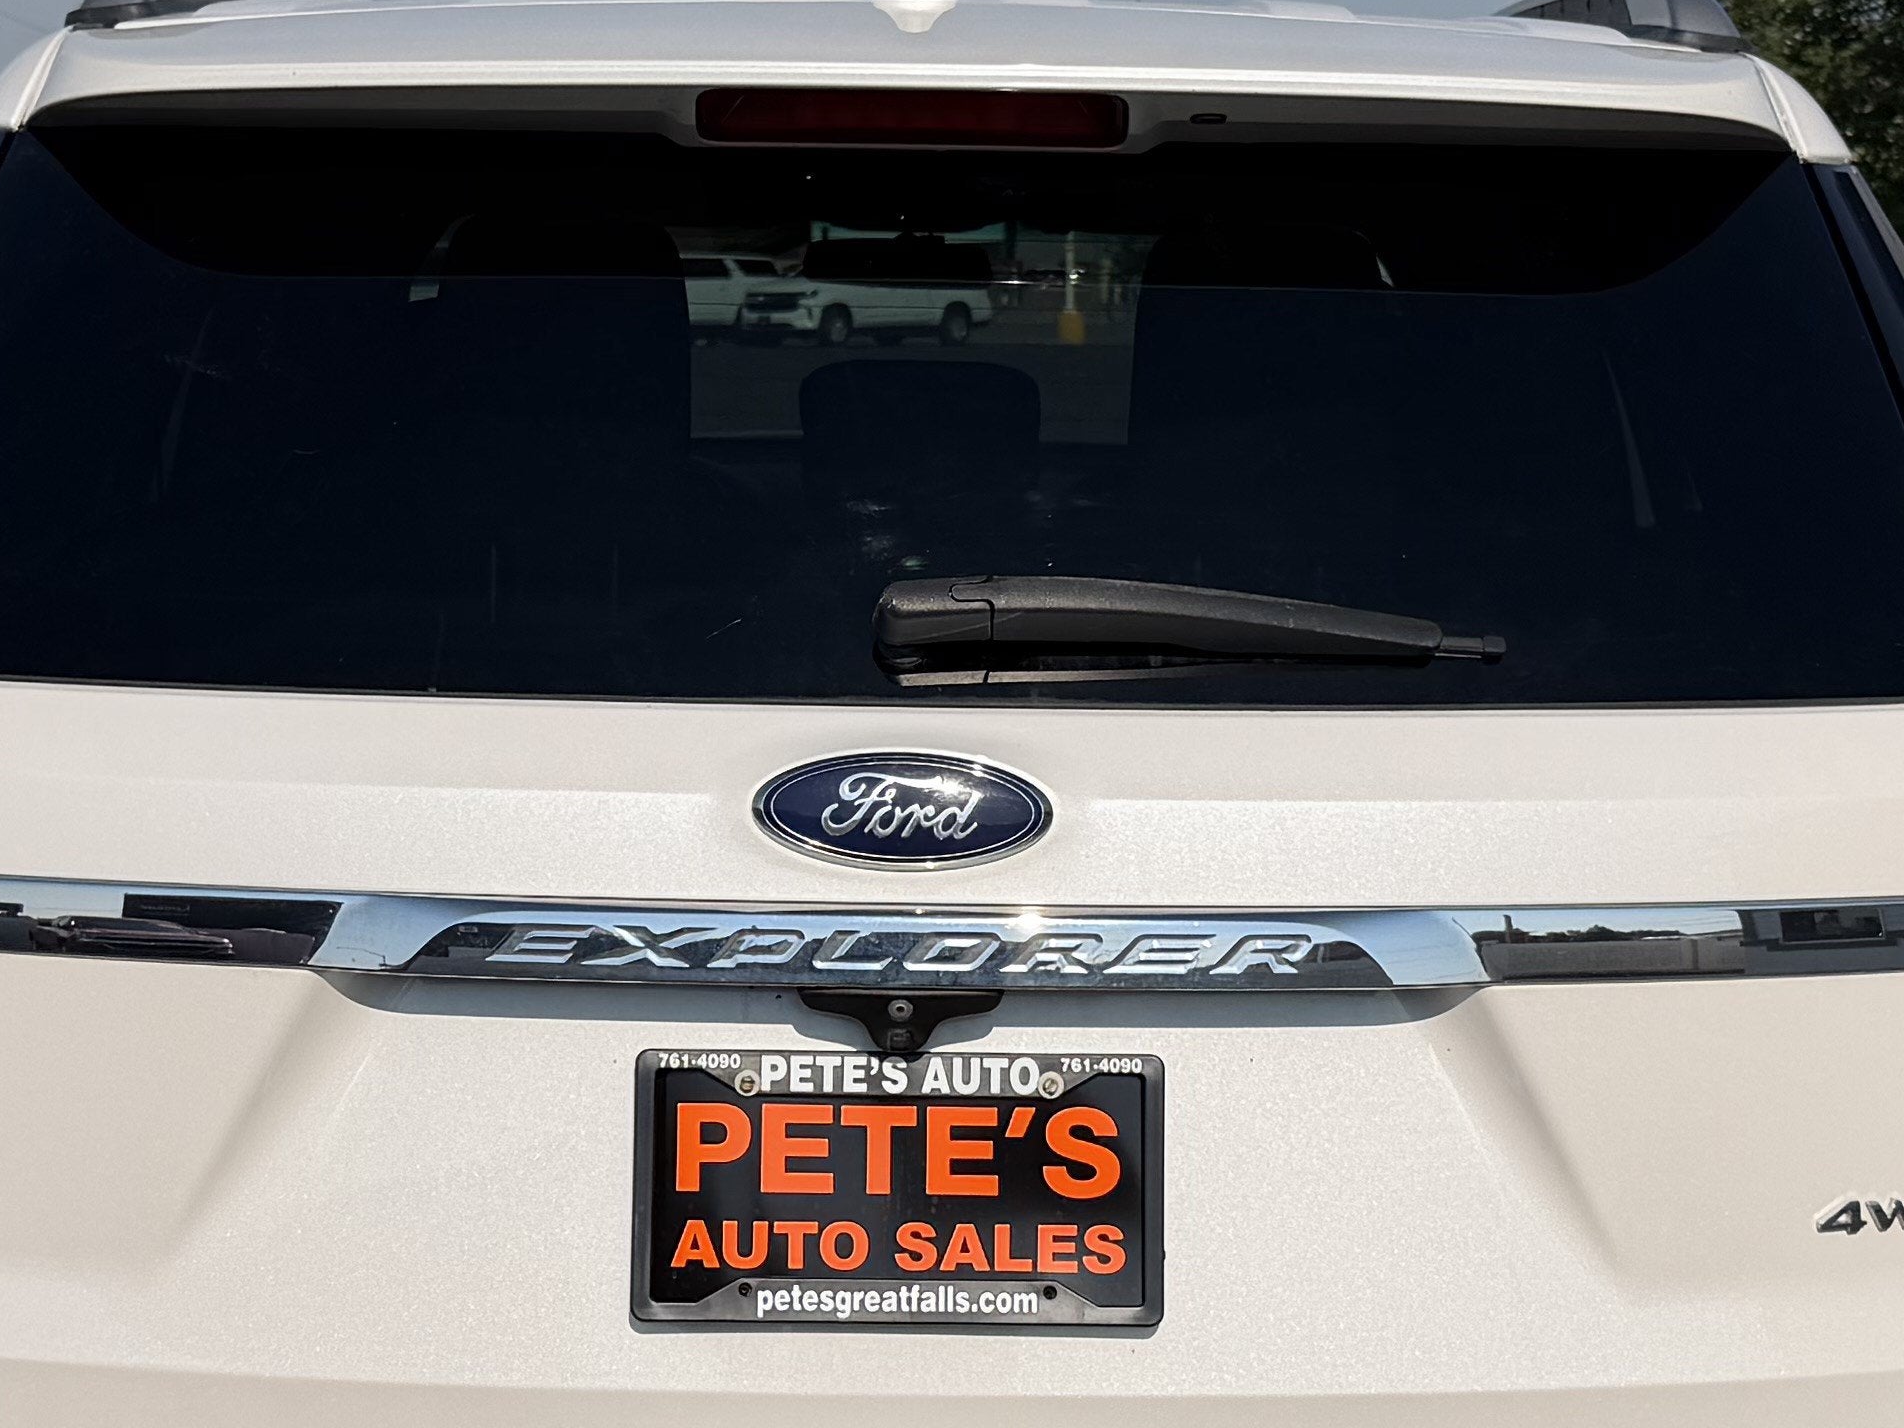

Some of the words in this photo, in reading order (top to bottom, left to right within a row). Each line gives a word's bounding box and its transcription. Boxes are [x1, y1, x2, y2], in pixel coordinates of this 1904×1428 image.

[822, 772, 979, 842] Ford
[486, 924, 1312, 974] EXPLORER
[760, 1055, 908, 1095] PETE'S
[921, 1057, 1041, 1096] AUTO
[674, 1102, 1122, 1199] PETE'S
[671, 1220, 870, 1271] AUTO
[895, 1222, 1127, 1275] SALES
[757, 1285, 1039, 1319] petesgreatfalls.com
